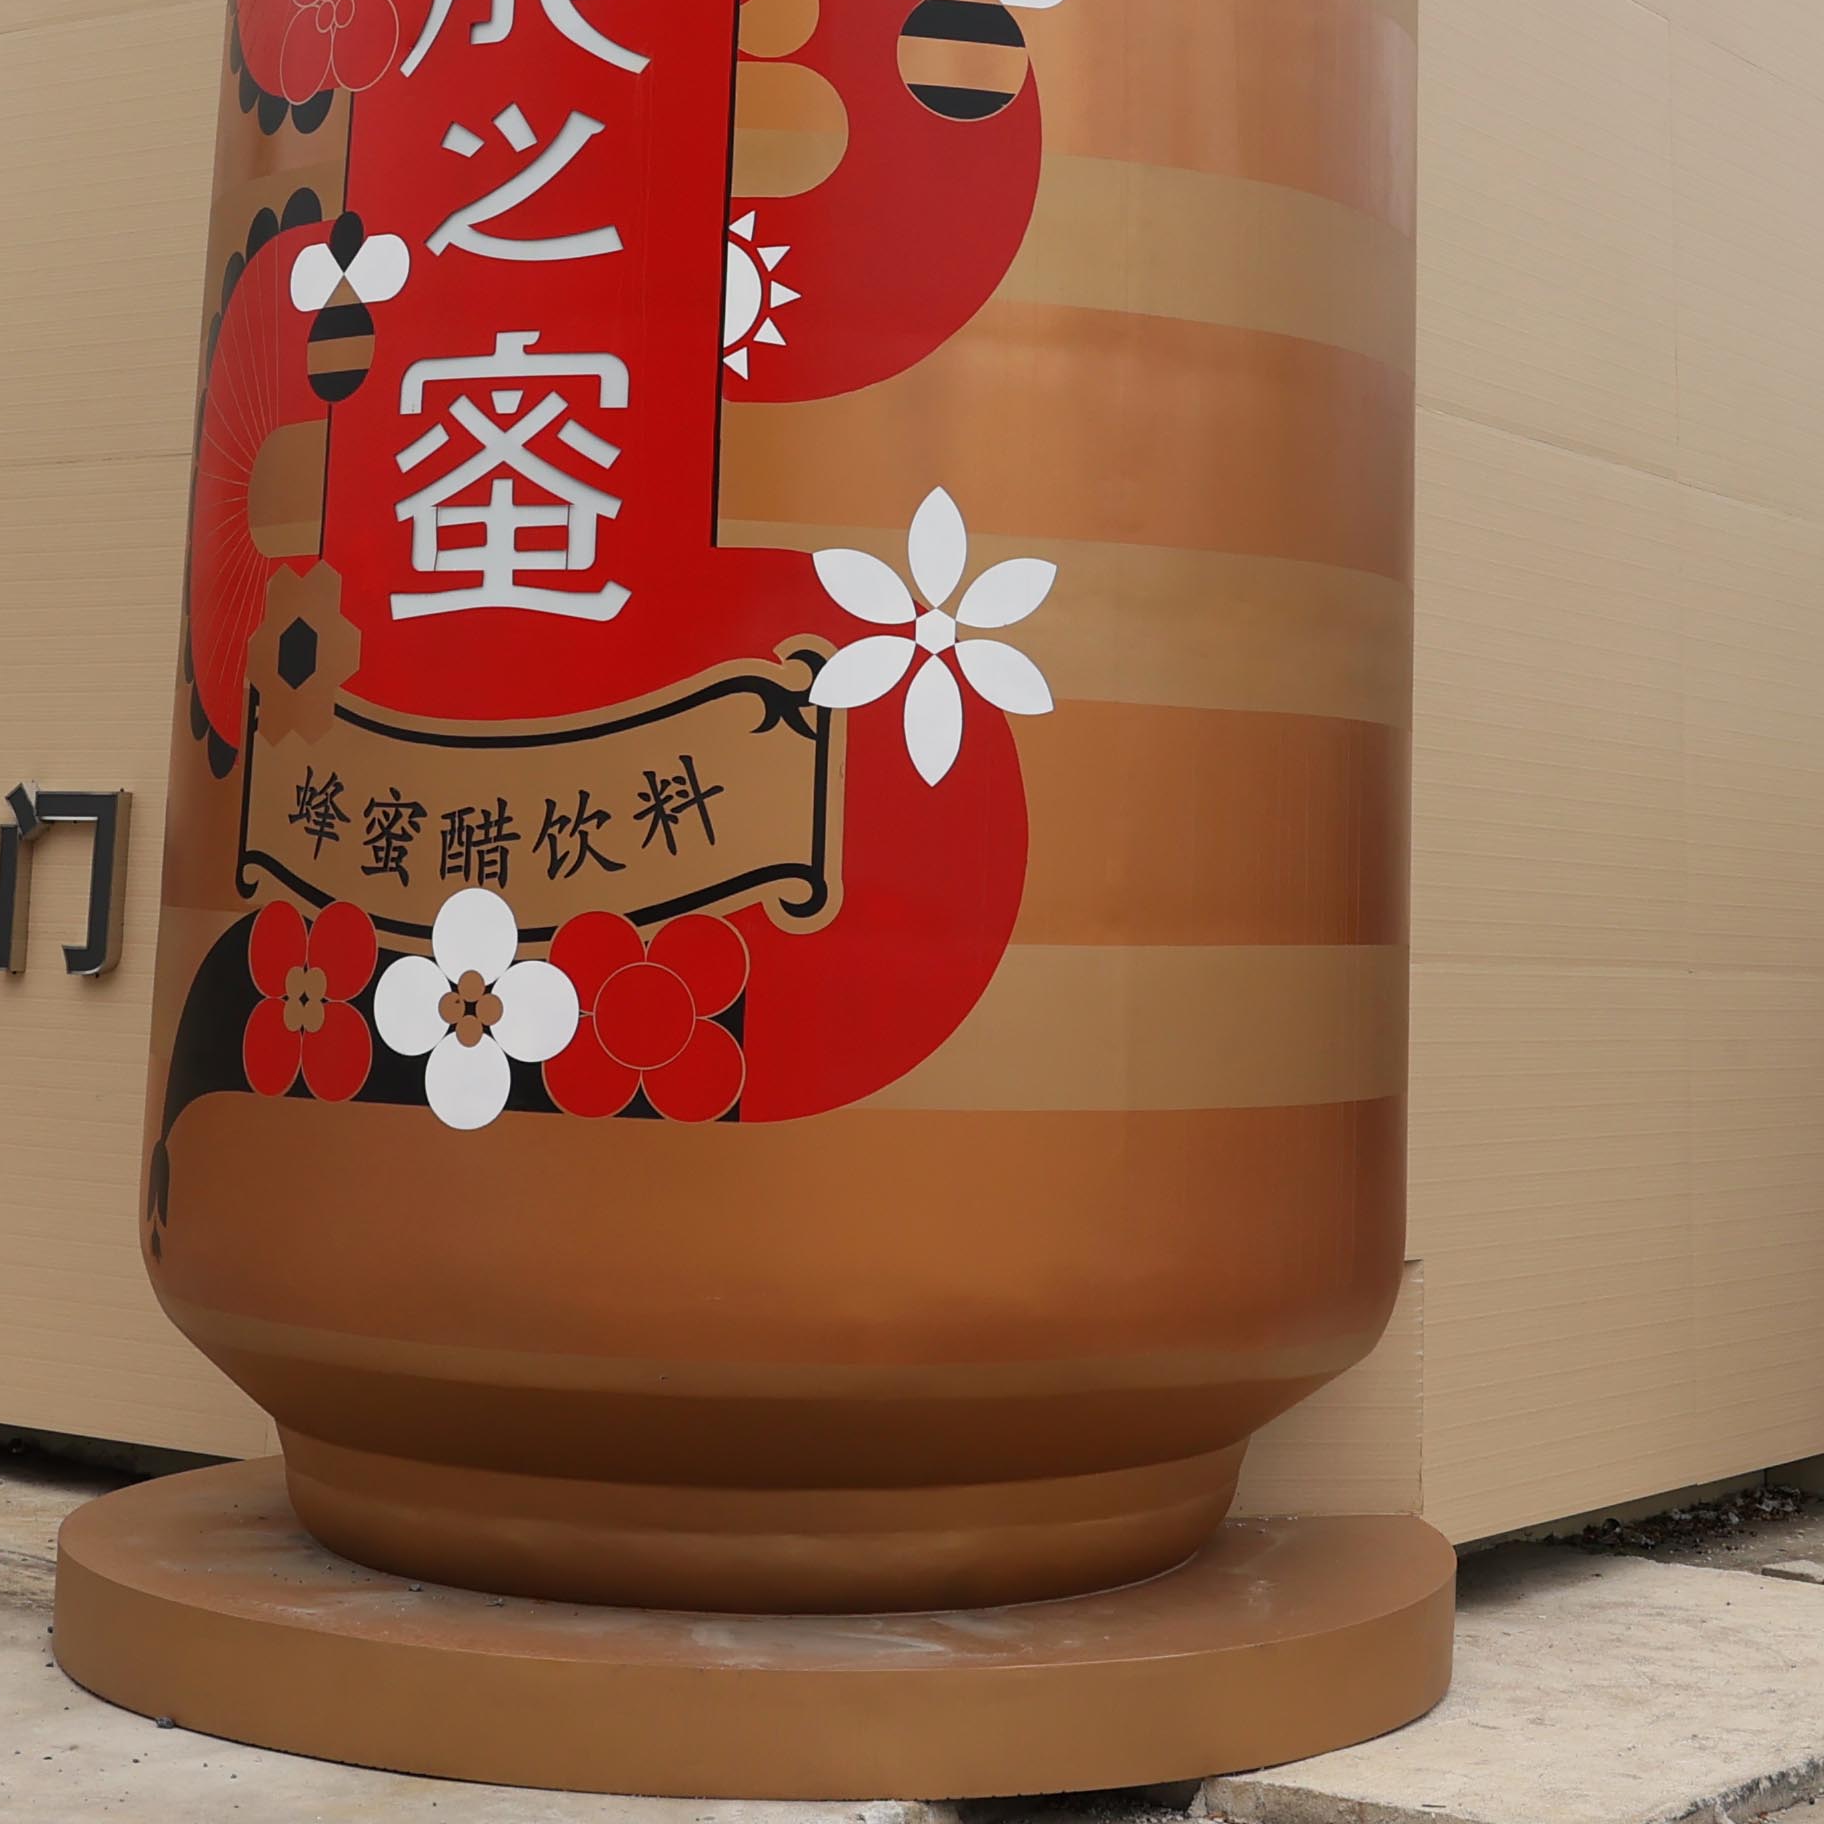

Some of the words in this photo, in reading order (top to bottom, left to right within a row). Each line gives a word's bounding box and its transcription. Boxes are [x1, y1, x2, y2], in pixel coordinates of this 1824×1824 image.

[285, 753, 724, 887] 蜂蜜醋饮料
